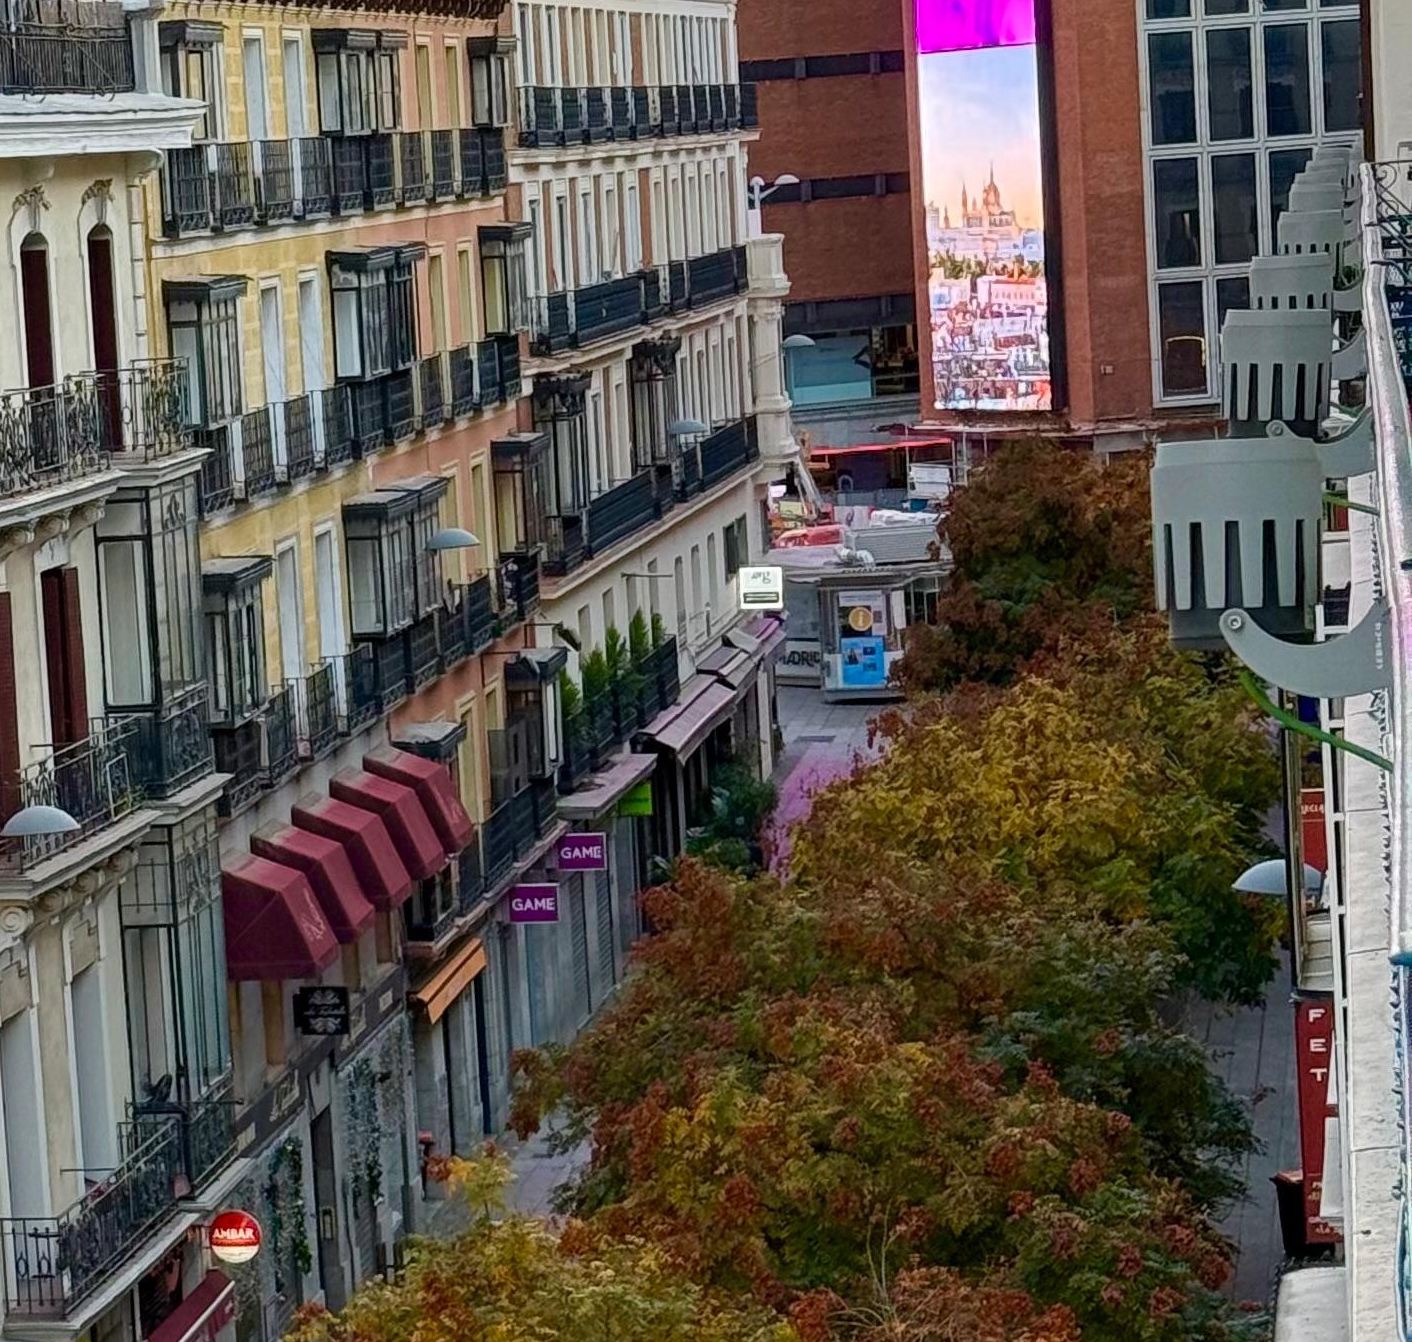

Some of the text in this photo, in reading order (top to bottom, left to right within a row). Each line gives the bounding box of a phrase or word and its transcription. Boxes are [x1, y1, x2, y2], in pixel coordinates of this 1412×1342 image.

[560, 845, 602, 859] GAME
[511, 897, 556, 911] GAME
[212, 1227, 257, 1240] AMBAR
